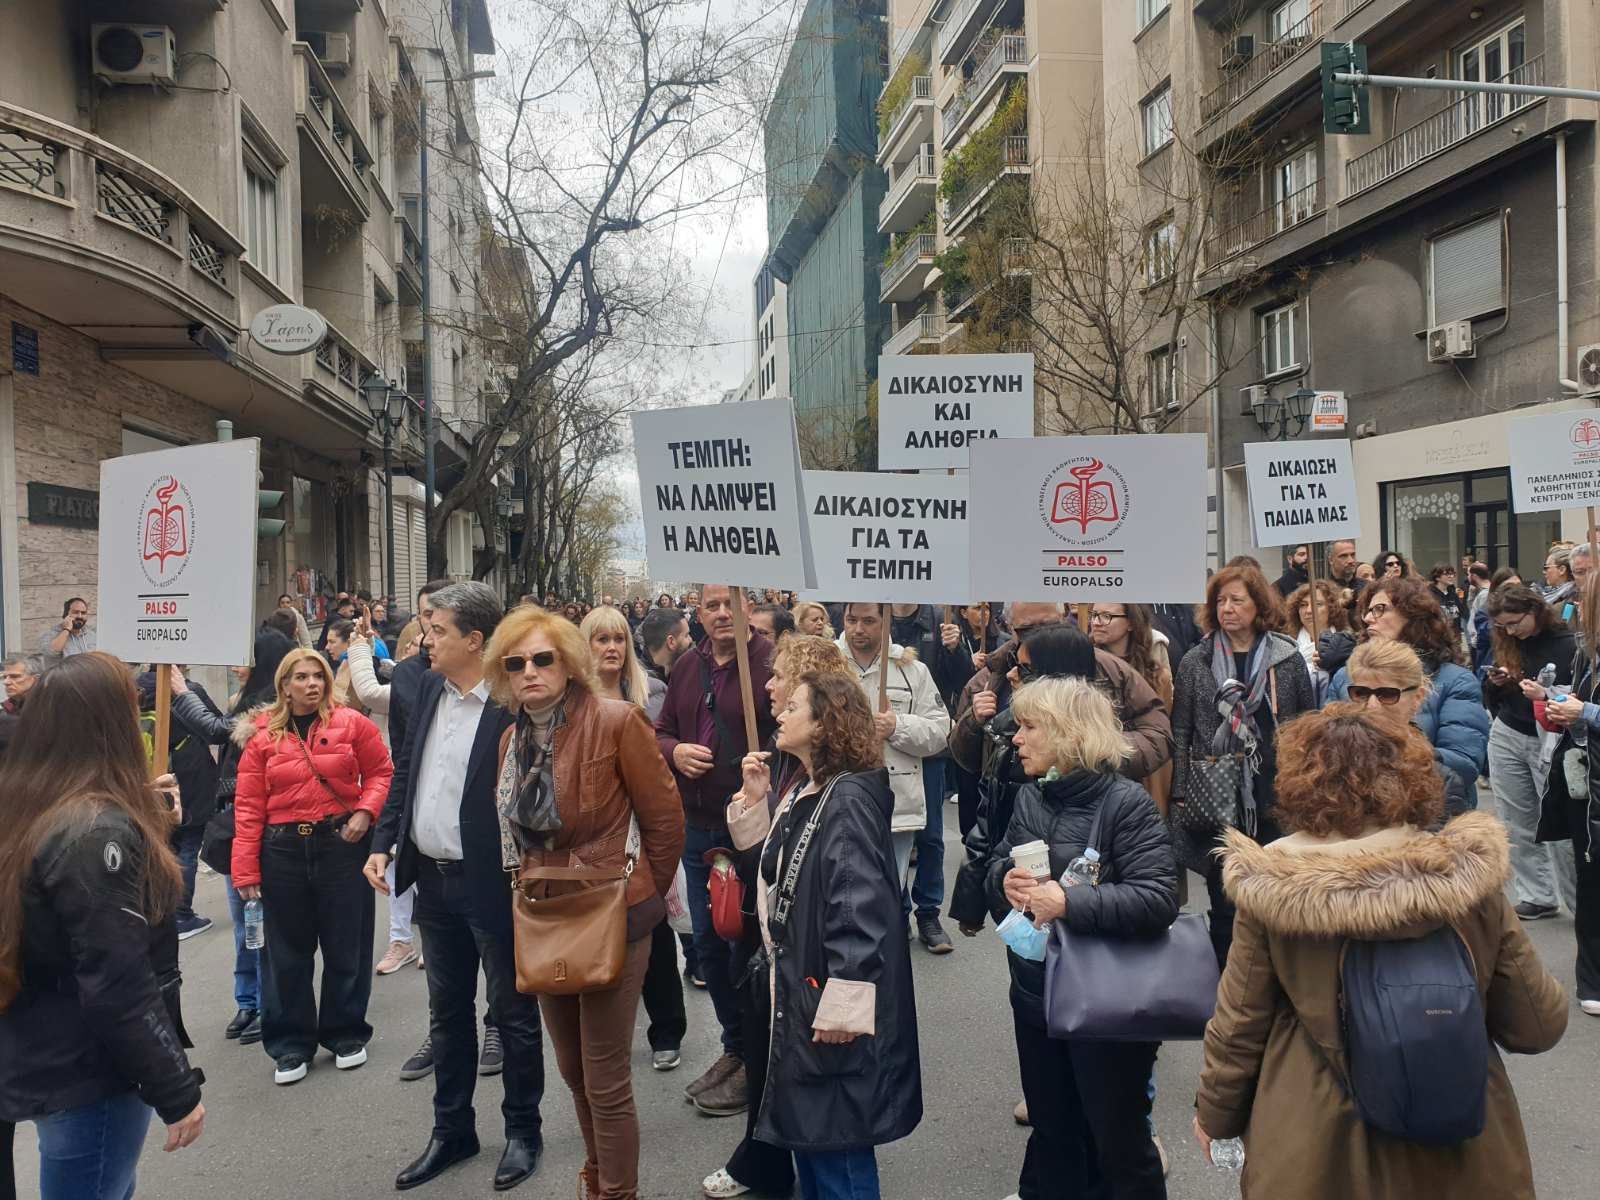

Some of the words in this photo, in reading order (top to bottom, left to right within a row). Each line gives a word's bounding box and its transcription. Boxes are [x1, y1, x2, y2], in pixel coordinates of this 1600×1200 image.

[888, 375, 1023, 395] ΔΙΚΑΙΟΣΥΝΗ
[934, 403, 971, 421] ΚΑΙ
[668, 438, 752, 470] ΤΕΜΠΗ:
[1268, 458, 1337, 478] ΔΙΚΑΙΩΣΗ
[1527, 471, 1595, 484] ΠΑΝΕΛΛΗΝΙΟΣ
[1280, 484, 1305, 502] ΓΙΑ
[1307, 482, 1328, 500] ΤΑ
[1533, 480, 1591, 493] ΚΑΘΗΓΗΤΩΝ
[656, 484, 686, 511] ΝΑ
[691, 482, 777, 512] ΛΑΜΨΕΙ
[1530, 492, 1574, 503] ΚΕΝΤΡΩΝ
[814, 495, 967, 520] ΔΙΚΑΙΟΣΥΝΗ
[1264, 509, 1315, 528] ΠΑΙΔΙΑ
[1317, 505, 1348, 523] ΜΑΣ
[663, 525, 679, 552] Η
[685, 525, 781, 557] ΑΛΗΘΕΙΑ
[852, 528, 891, 549] ΓΙΑ
[898, 529, 930, 550] ΤΑ
[847, 558, 932, 581] ΤΕΜΠΗ
[1057, 555, 1108, 567] PALSO
[1043, 576, 1124, 587] EUROPALSO
[145, 601, 177, 615] PALSO
[137, 628, 188, 641] EUROPALSO
